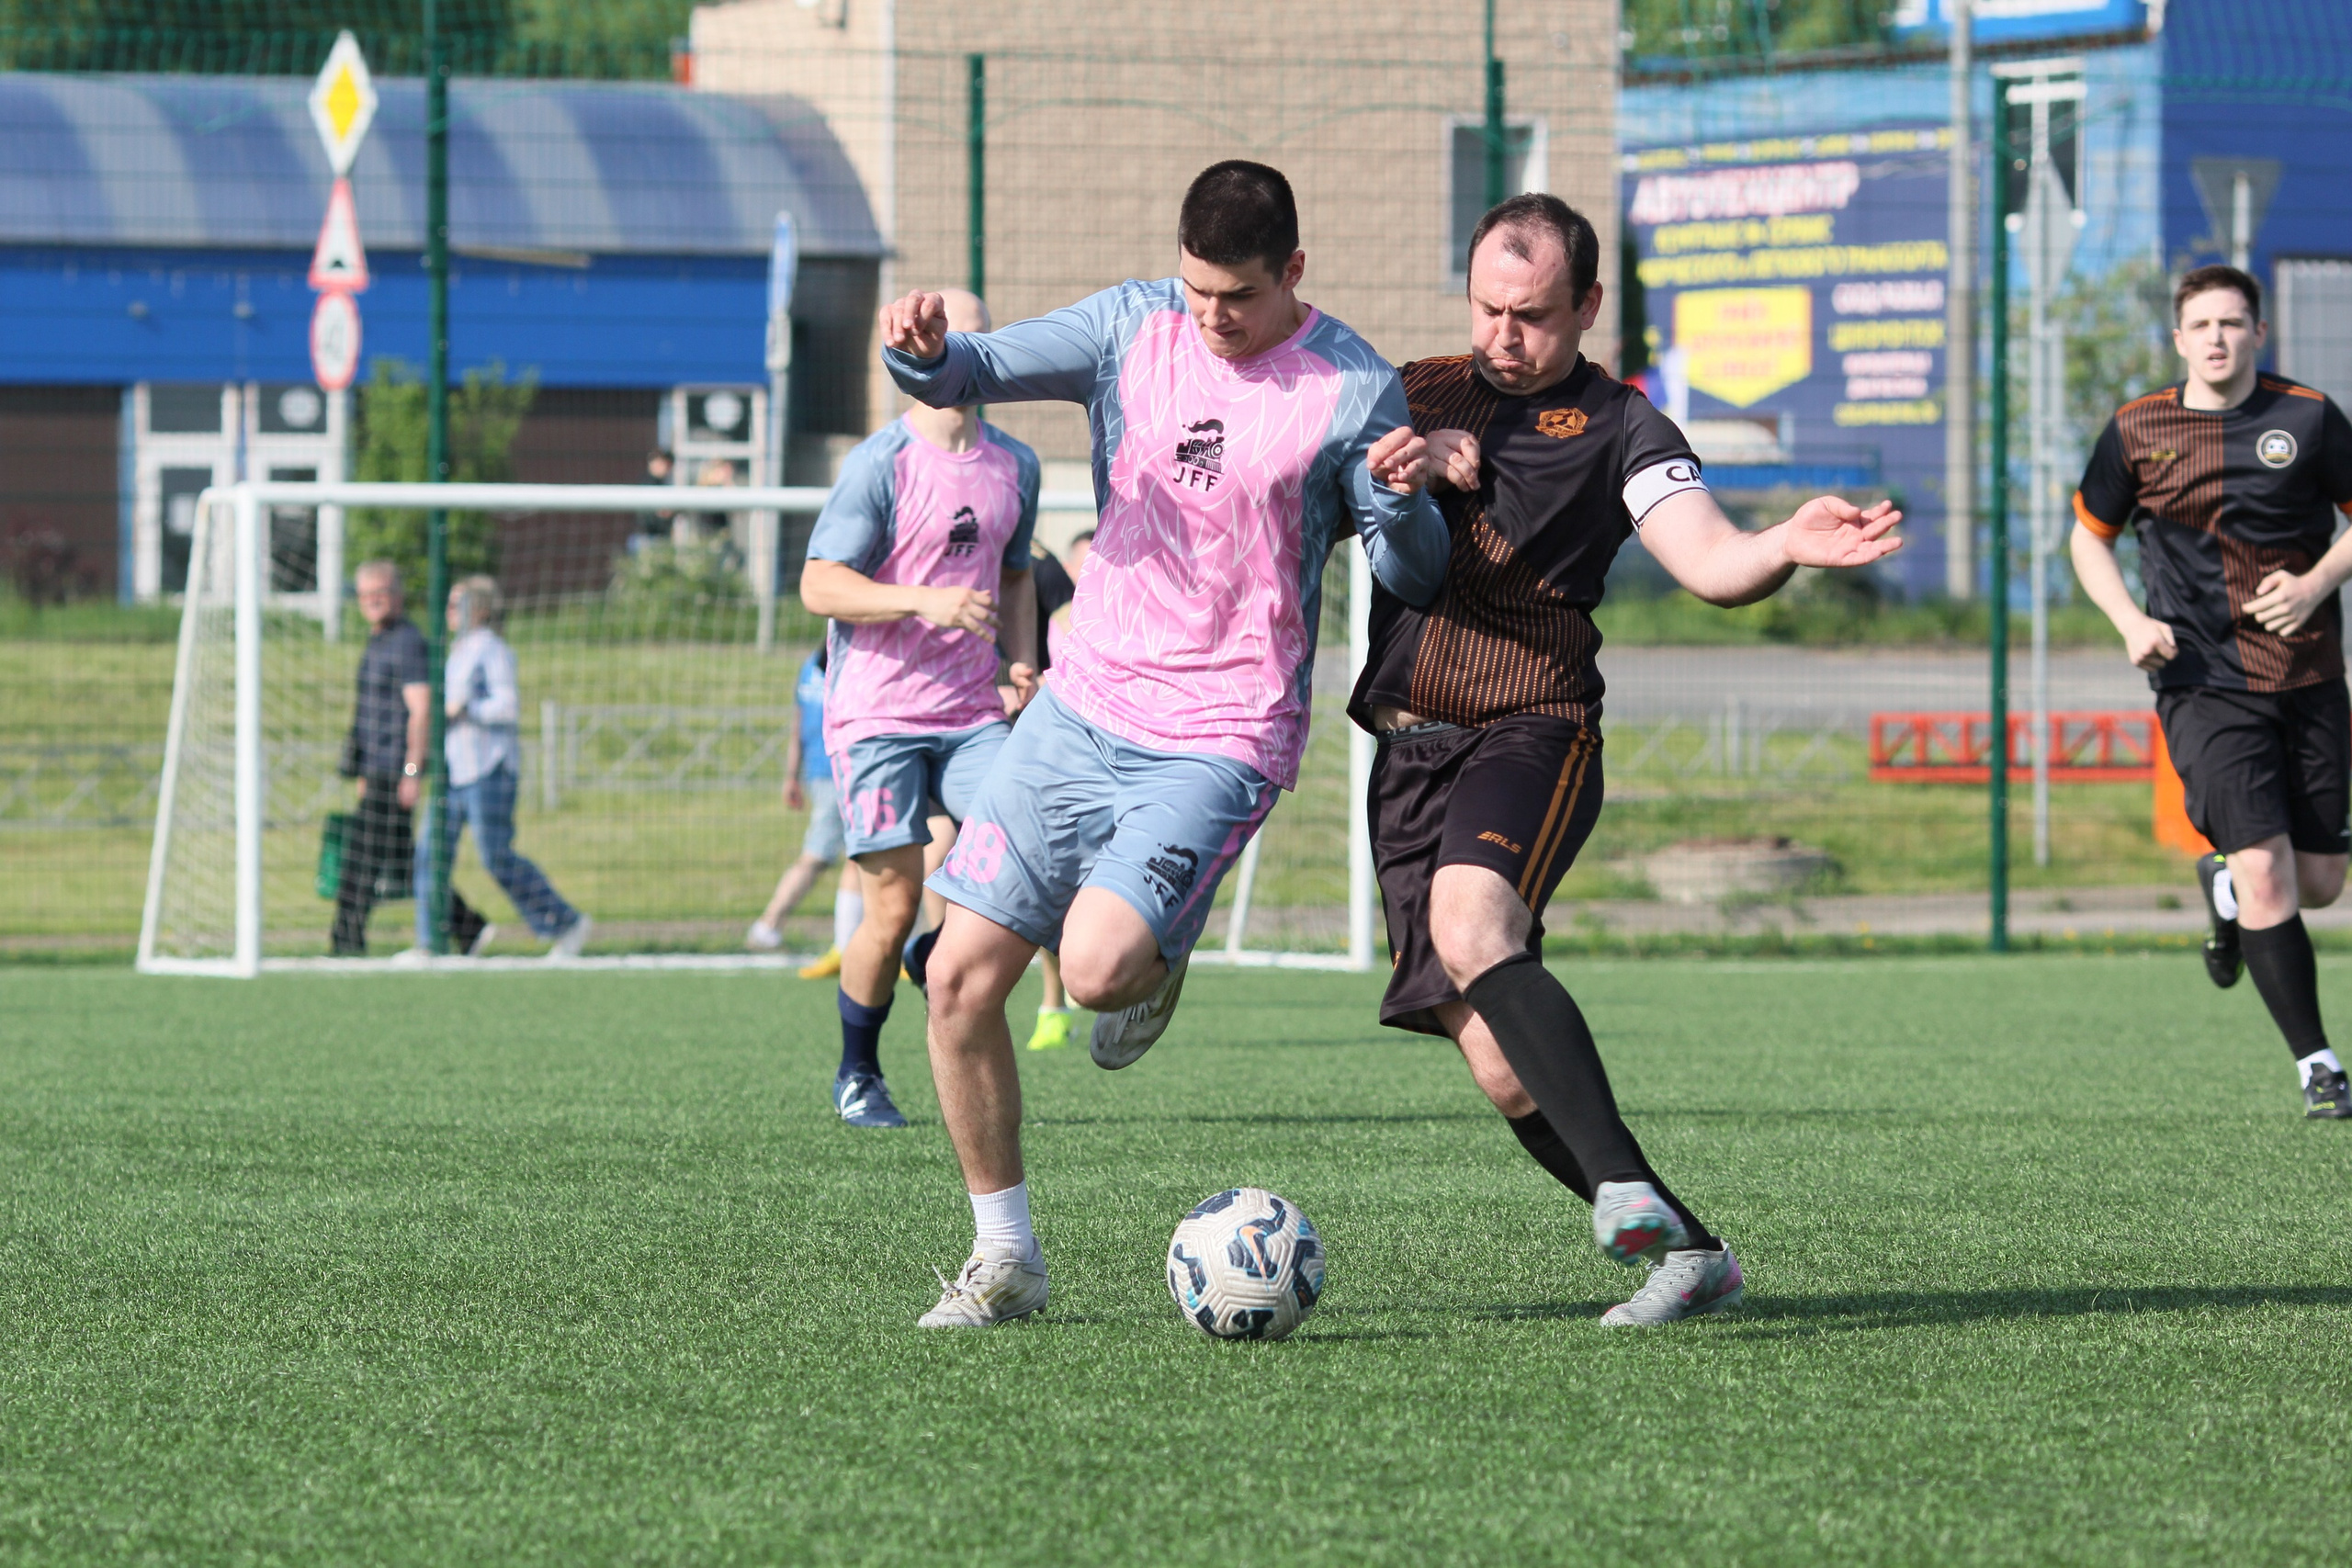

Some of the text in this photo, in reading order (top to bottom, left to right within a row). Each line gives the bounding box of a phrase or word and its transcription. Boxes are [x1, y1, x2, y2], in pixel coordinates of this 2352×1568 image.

[1173, 467, 1217, 491] JFF
[944, 544, 976, 558] JFF
[856, 787, 897, 837] 16
[946, 815, 1007, 884] 38
[1476, 830, 1522, 854] ERLS
